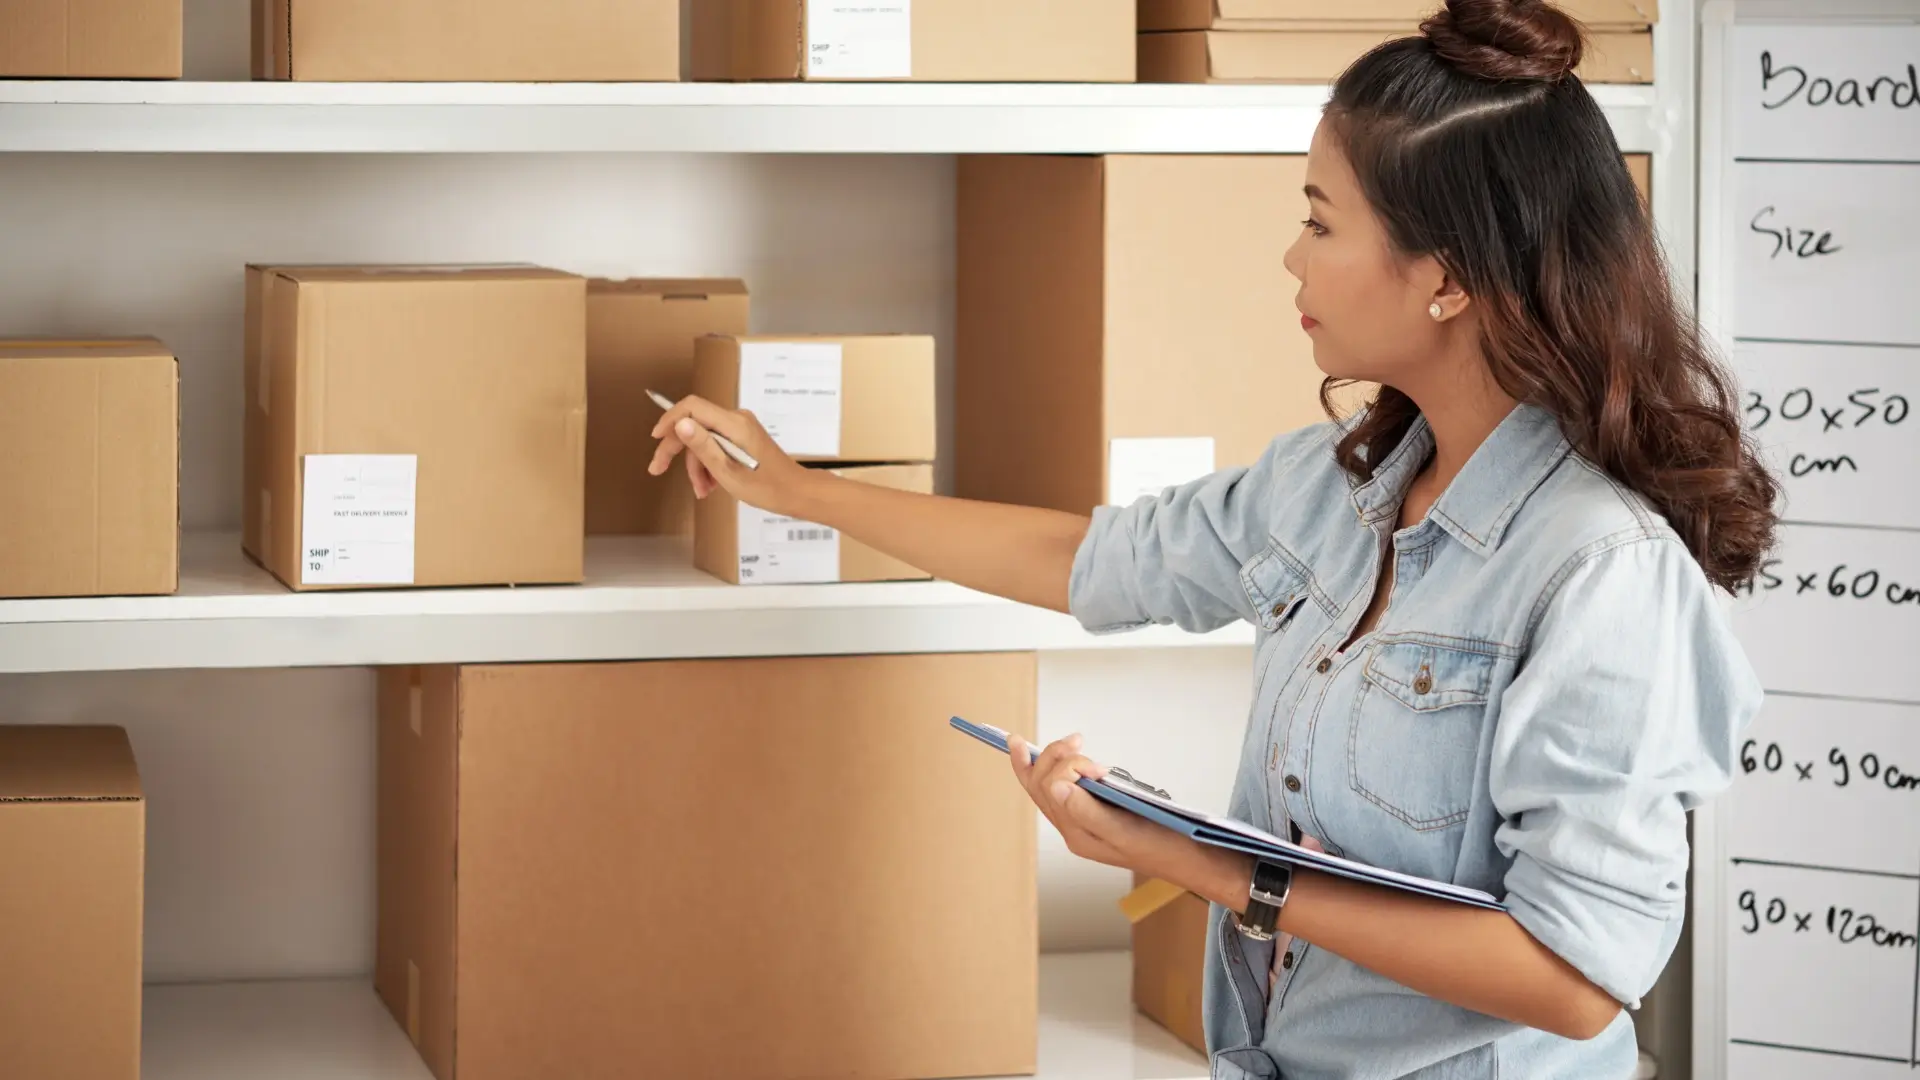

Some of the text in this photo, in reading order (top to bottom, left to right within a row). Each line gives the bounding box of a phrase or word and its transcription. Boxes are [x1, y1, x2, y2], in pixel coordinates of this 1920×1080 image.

[1760, 50, 1920, 110] Board
[1750, 206, 1841, 259] Size
[1789, 453, 1858, 478] cm
[333, 509, 408, 517] FAST DELIVERY SERVICE
[309, 548, 330, 558] SHIP
